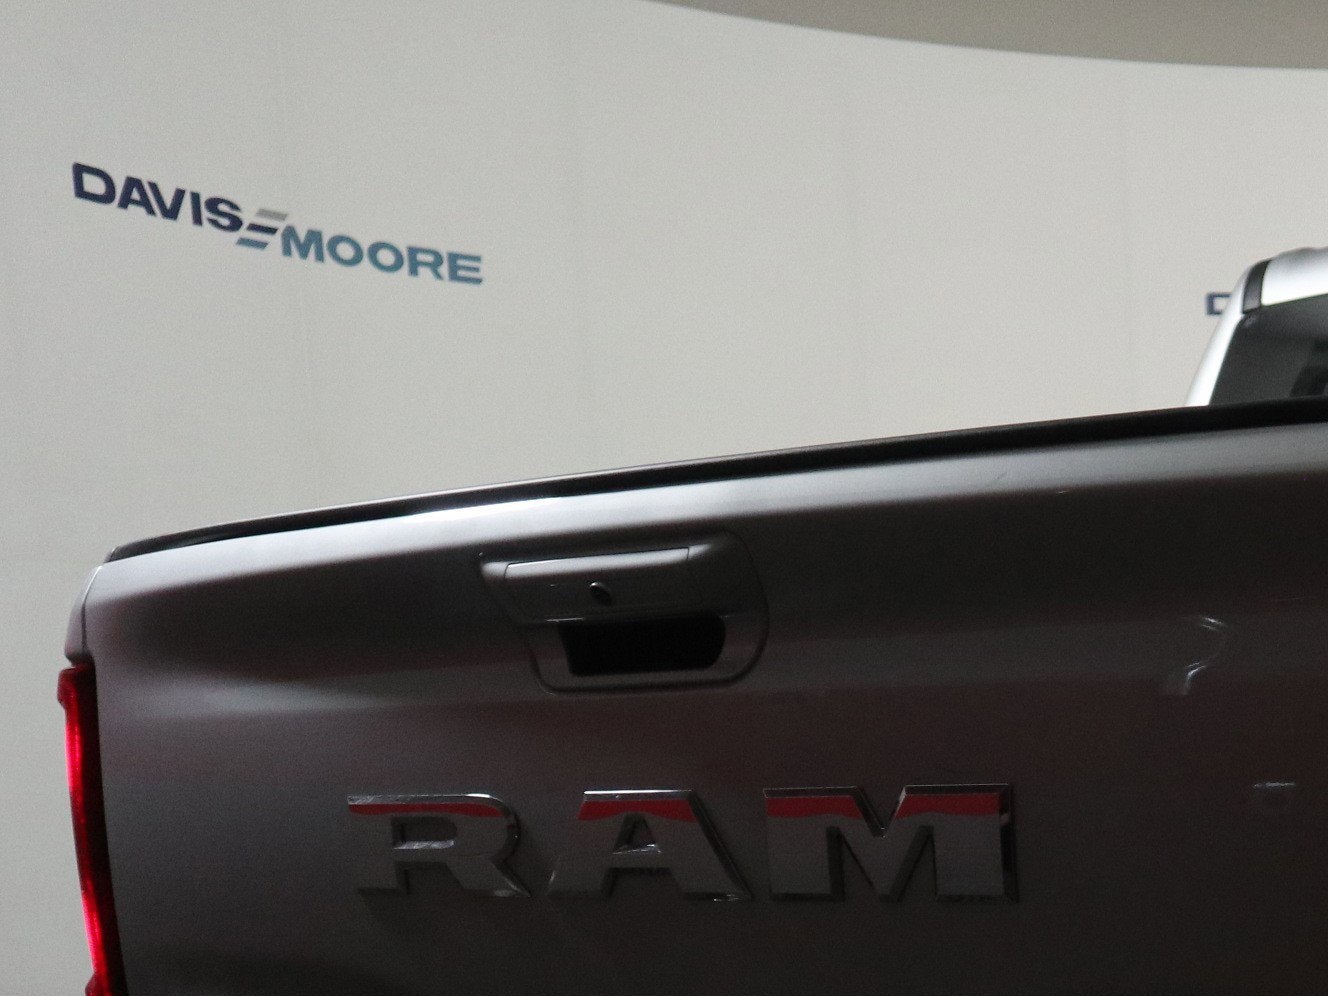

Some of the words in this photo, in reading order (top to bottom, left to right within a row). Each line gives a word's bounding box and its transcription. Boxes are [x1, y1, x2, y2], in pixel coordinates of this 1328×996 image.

[72, 162, 243, 233] DAVIS
[280, 225, 484, 285] MOORE
[347, 783, 1018, 901] RAM
